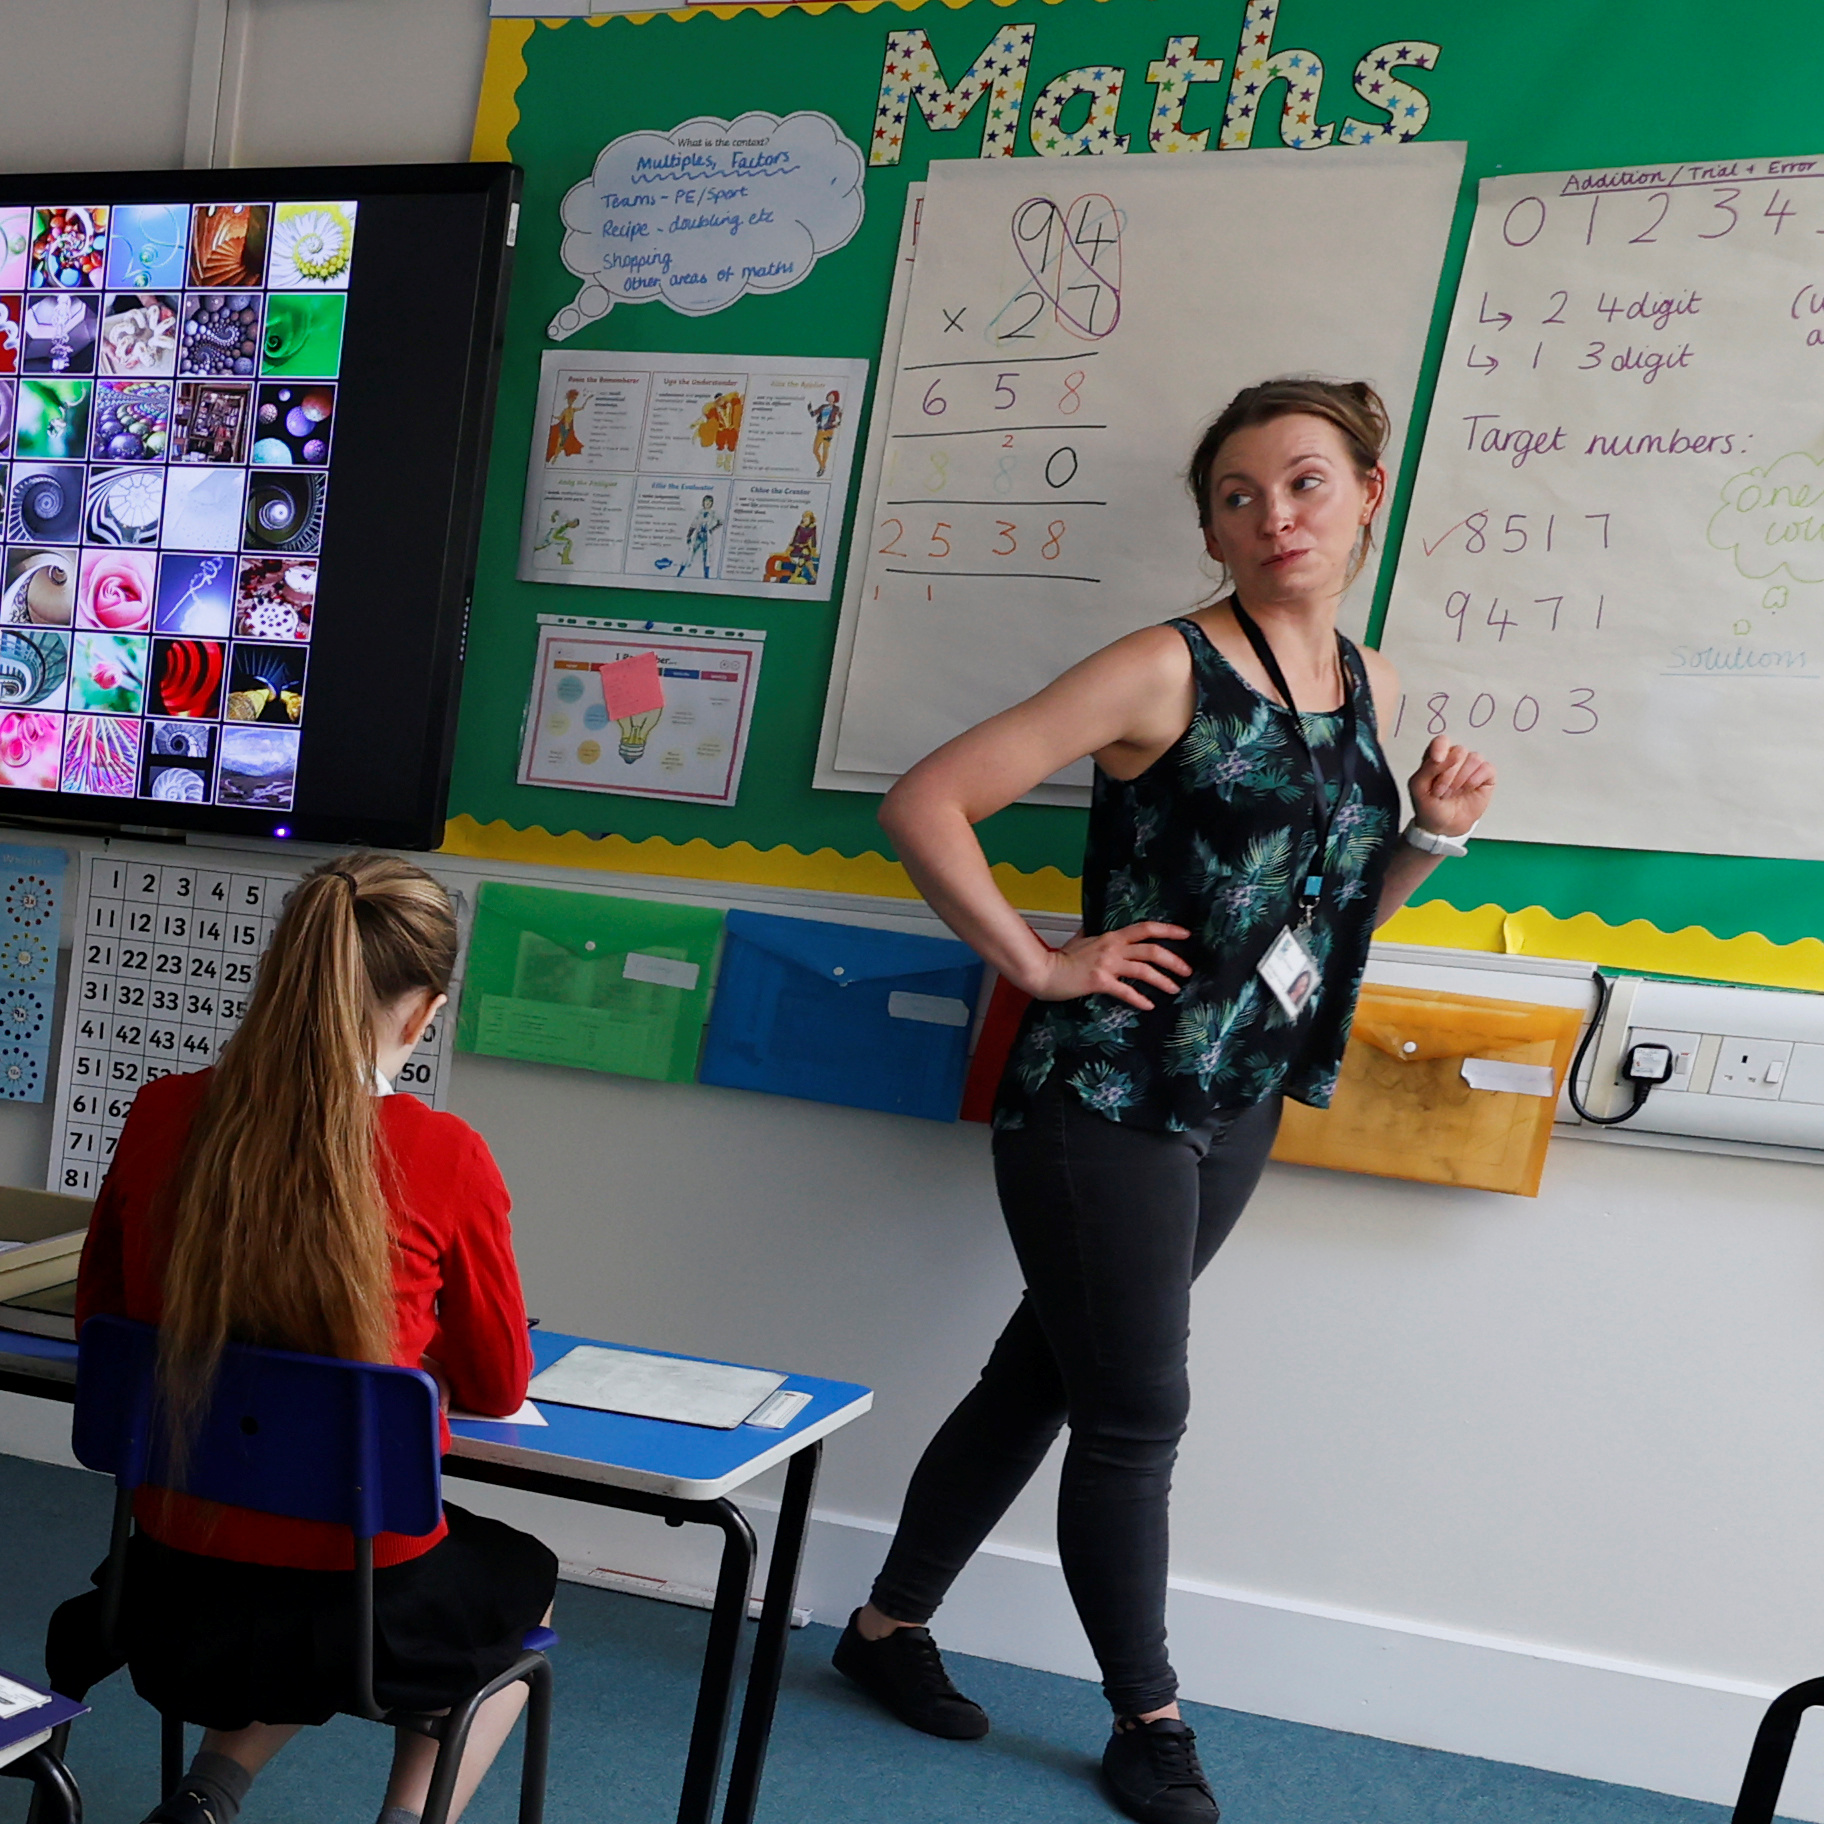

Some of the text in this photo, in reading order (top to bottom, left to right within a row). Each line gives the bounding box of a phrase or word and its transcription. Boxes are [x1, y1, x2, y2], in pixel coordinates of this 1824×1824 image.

[869, 0, 1441, 166] Maths
[678, 139, 701, 147] What
[705, 139, 713, 147] is
[715, 138, 730, 147] the
[637, 151, 789, 171] Multiples, Factors
[1769, 160, 1817, 175] Error
[601, 194, 656, 208] Teams
[1503, 187, 1797, 246] 0 1 2 3 4
[603, 219, 649, 241] Recipe
[603, 248, 672, 273] Shopping
[624, 277, 659, 292] Other
[670, 272, 707, 286] areas
[717, 265, 734, 282] of
[1541, 290, 1568, 324] 2
[1463, 414, 1755, 469] Target numbers:
[114, 870, 259, 906] 1 2 3 4 5
[95, 907, 256, 946] 11 12 13 14 15
[87, 945, 252, 984] 21 22 23 24 25
[83, 981, 249, 1021] 31 32 33 34 35
[80, 1019, 431, 1083] 41 42 43 44 50
[76, 1056, 101, 1077] 51
[111, 1061, 138, 1082] 52
[72, 1094, 132, 1119] 61 62
[69, 1131, 118, 1155] 71 7
[64, 1168, 88, 1188] 81
